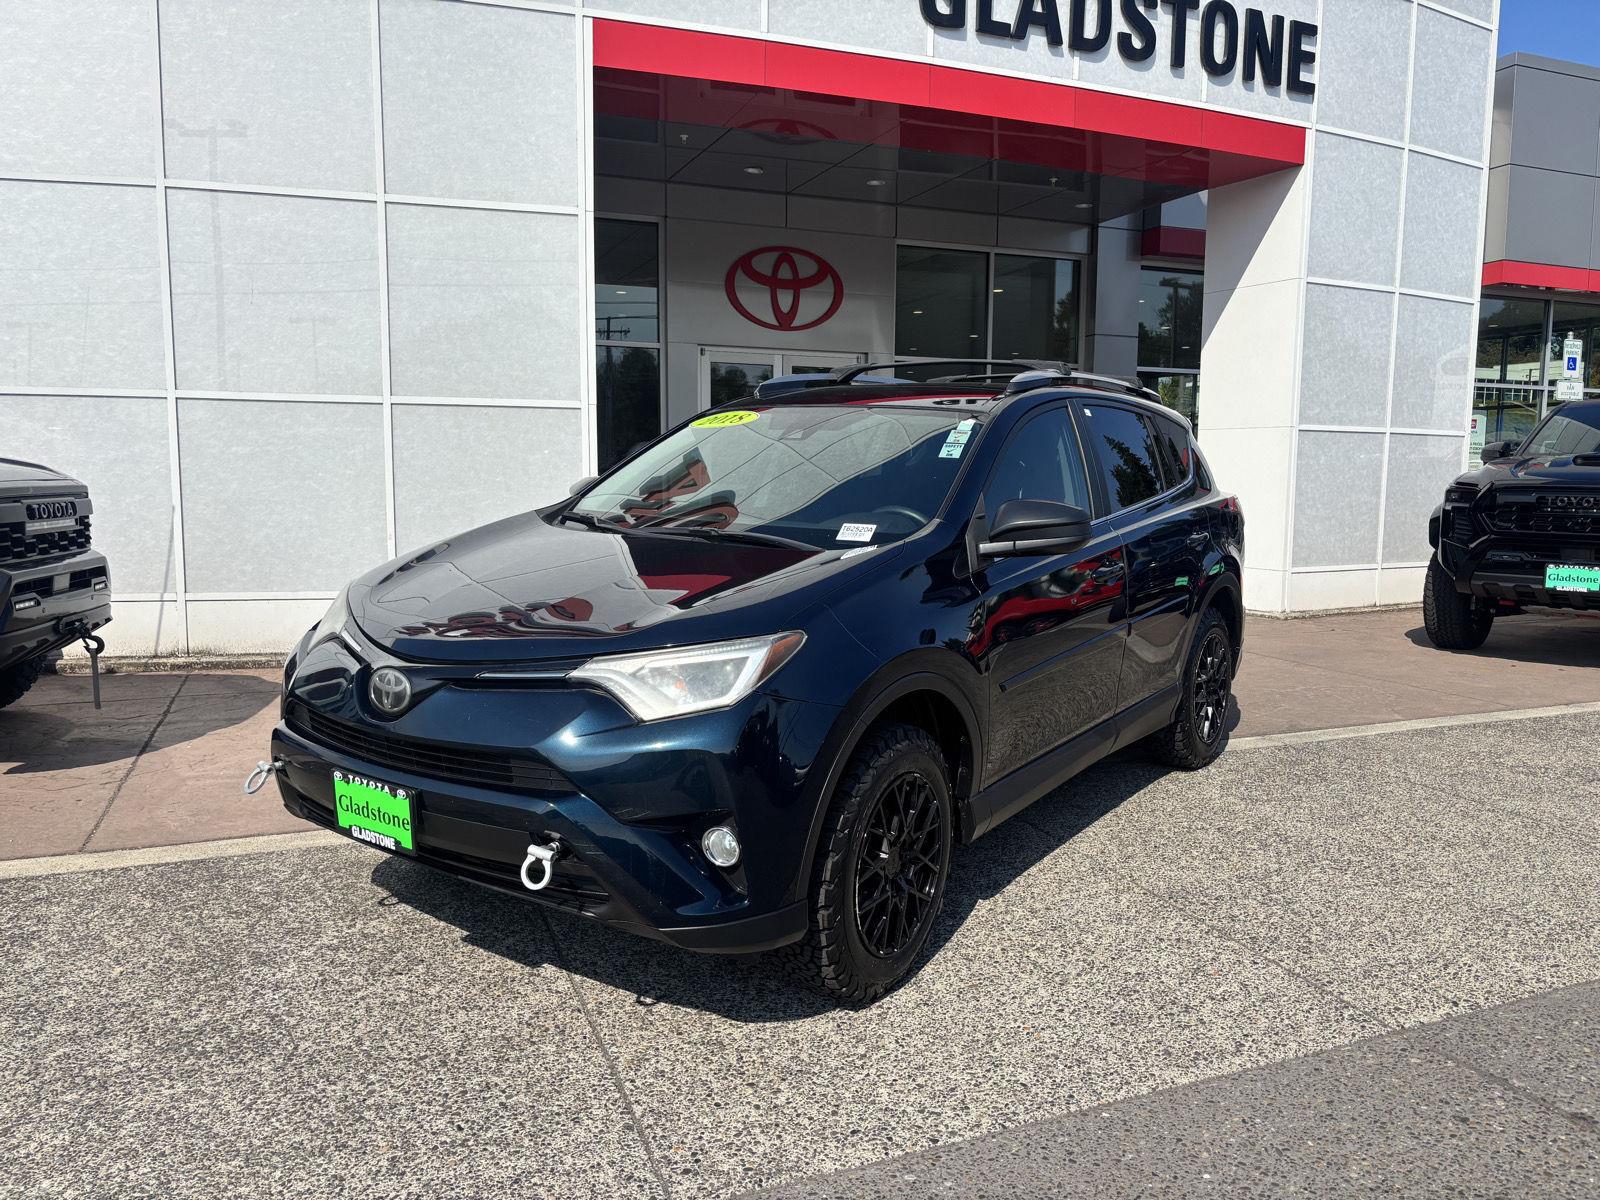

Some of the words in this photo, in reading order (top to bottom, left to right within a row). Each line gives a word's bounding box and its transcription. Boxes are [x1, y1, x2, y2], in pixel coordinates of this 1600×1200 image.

[32, 501, 74, 518] TOYOTA
[1546, 496, 1600, 507] TOYO
[1548, 573, 1599, 584] Gladstone
[347, 774, 390, 794] TOYOTA
[338, 794, 410, 831] Gladstone
[351, 826, 396, 850] GLADSTONE
